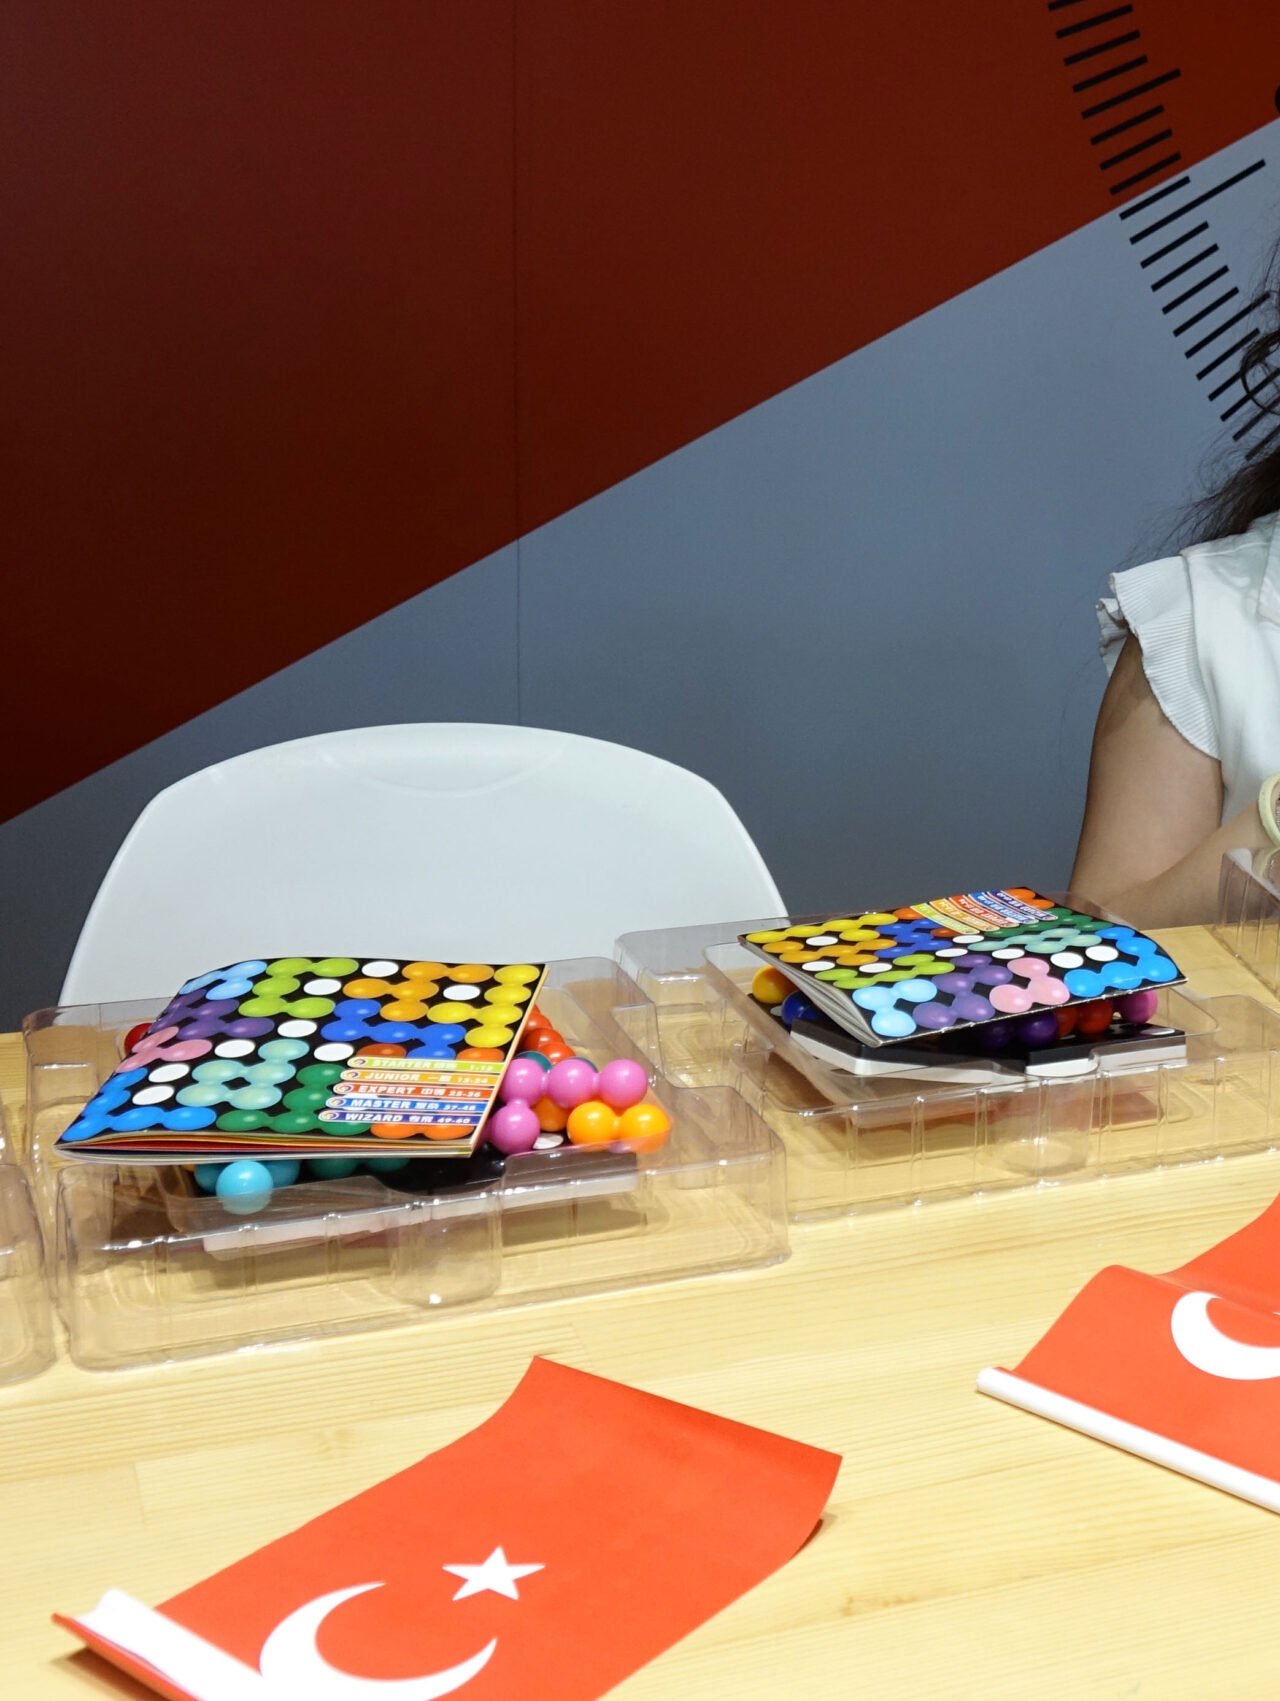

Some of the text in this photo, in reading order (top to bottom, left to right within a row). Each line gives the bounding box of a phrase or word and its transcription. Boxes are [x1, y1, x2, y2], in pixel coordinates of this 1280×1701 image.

[372, 1060, 432, 1069] STARTER
[365, 1072, 421, 1082] JUNIOR
[357, 1085, 417, 1095] EXPERT
[350, 1098, 412, 1110] MASTER
[344, 1112, 404, 1123] WIZARD
